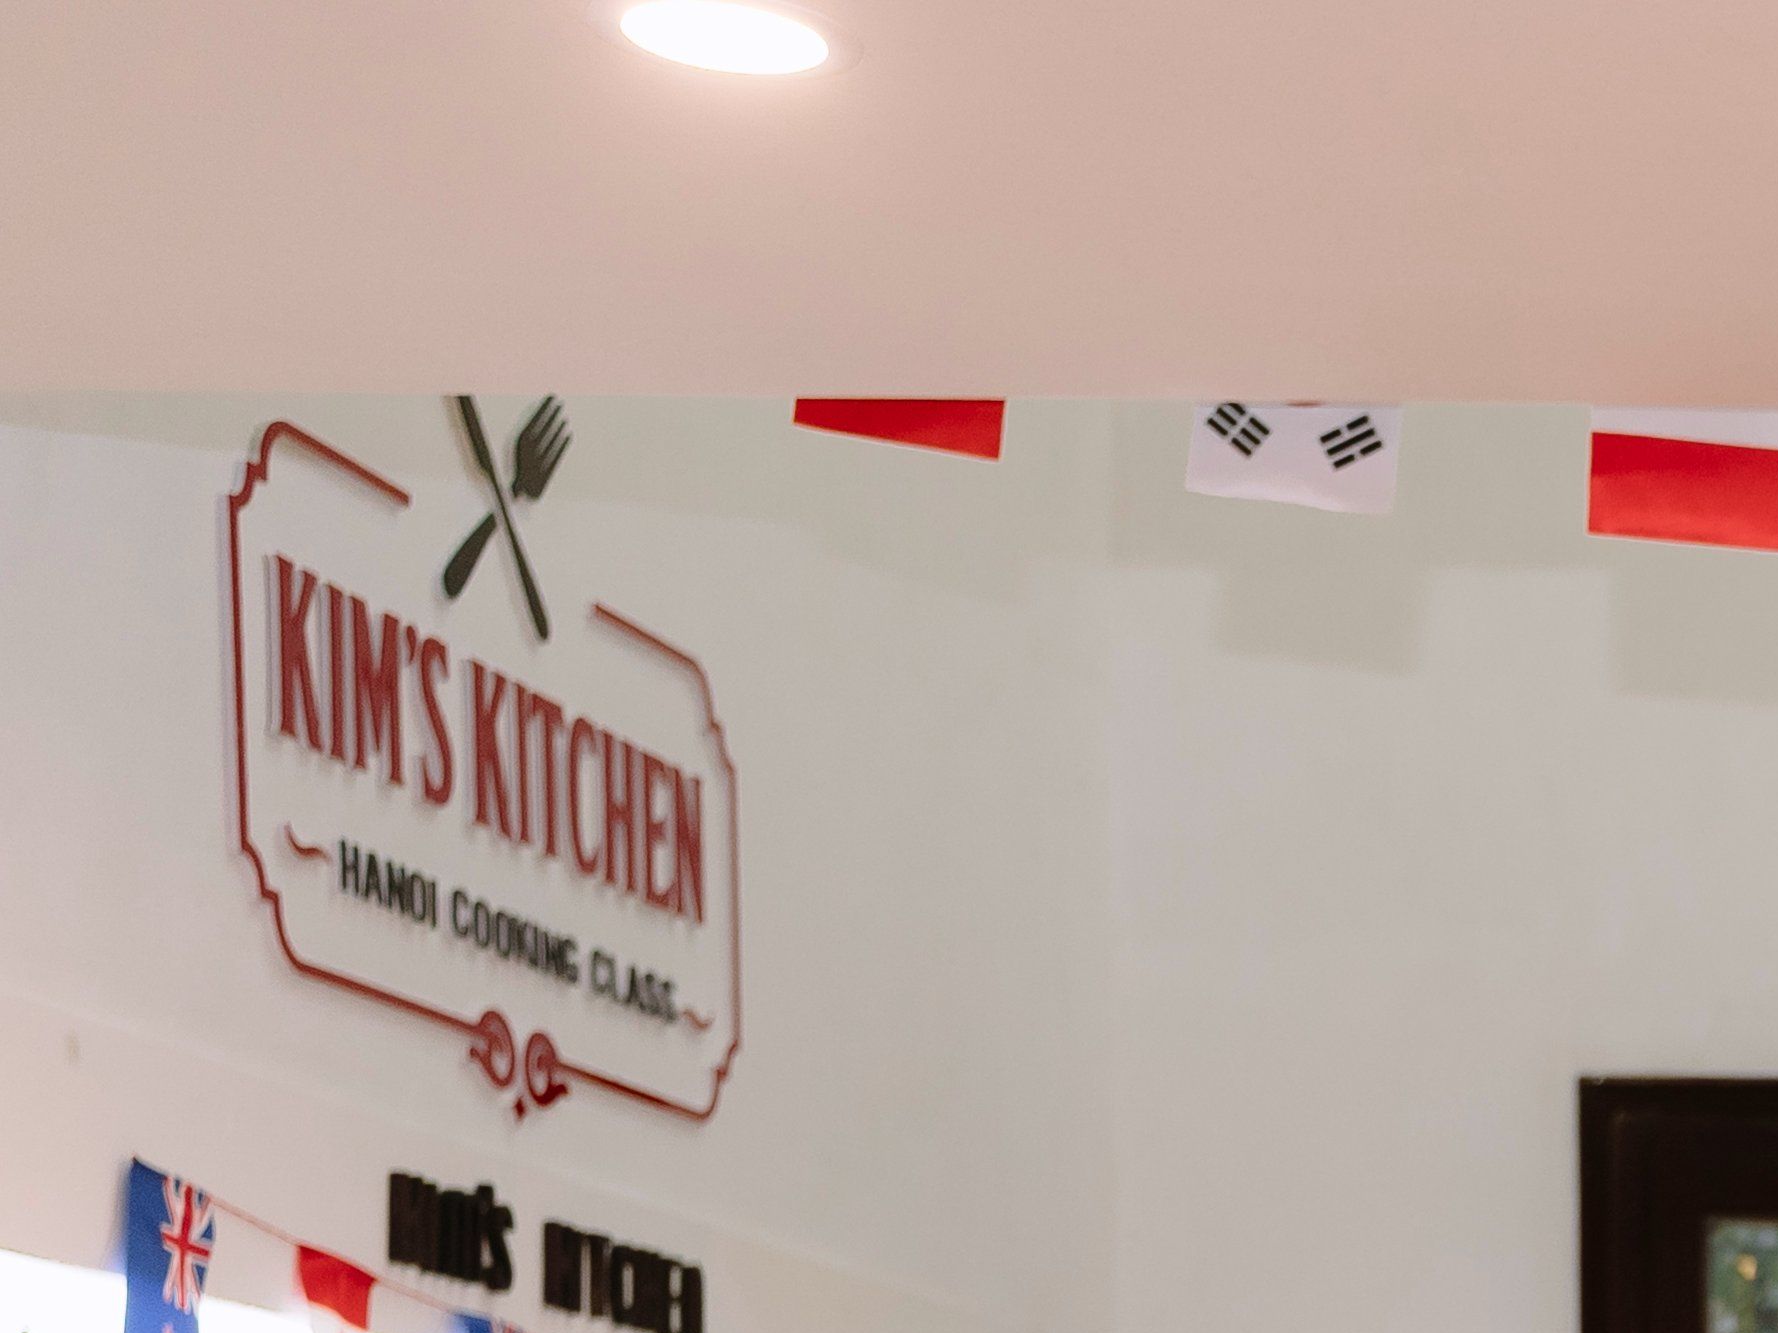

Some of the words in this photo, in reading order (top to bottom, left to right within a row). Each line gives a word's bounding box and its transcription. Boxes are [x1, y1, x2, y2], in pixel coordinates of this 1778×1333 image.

[272, 553, 454, 808] KIM'S
[470, 659, 704, 925] KITCHEN
[338, 839, 437, 930] HANOI
[451, 890, 579, 985] COOKING
